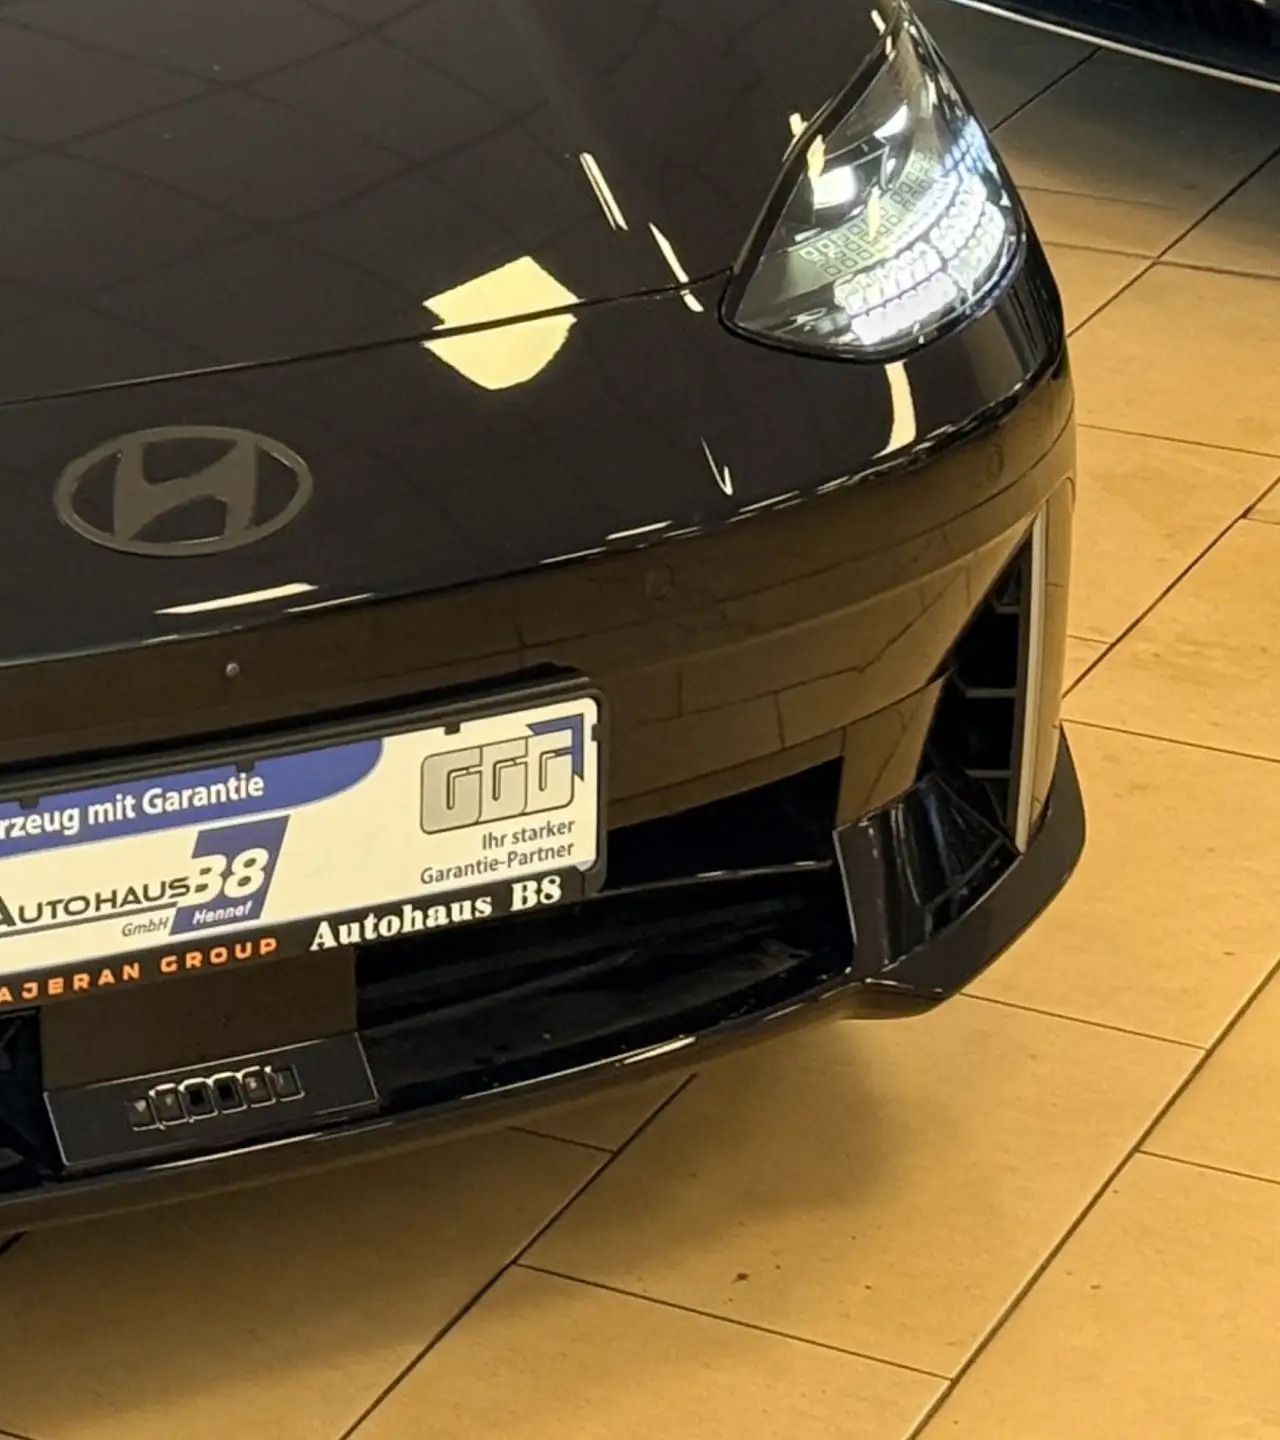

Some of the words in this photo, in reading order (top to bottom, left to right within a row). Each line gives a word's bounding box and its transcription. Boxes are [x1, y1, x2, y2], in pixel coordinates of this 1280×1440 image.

[88, 793, 137, 825] mit
[142, 772, 265, 815] Garantie
[482, 831, 509, 851] Ihr
[511, 820, 576, 845] starker
[189, 847, 270, 907] B8
[420, 842, 575, 885] Garantie-Partner
[122, 916, 170, 937] GmbH
[309, 895, 493, 951] Autohaus
[510, 874, 562, 911] B8
[160, 937, 279, 974] GROUP
